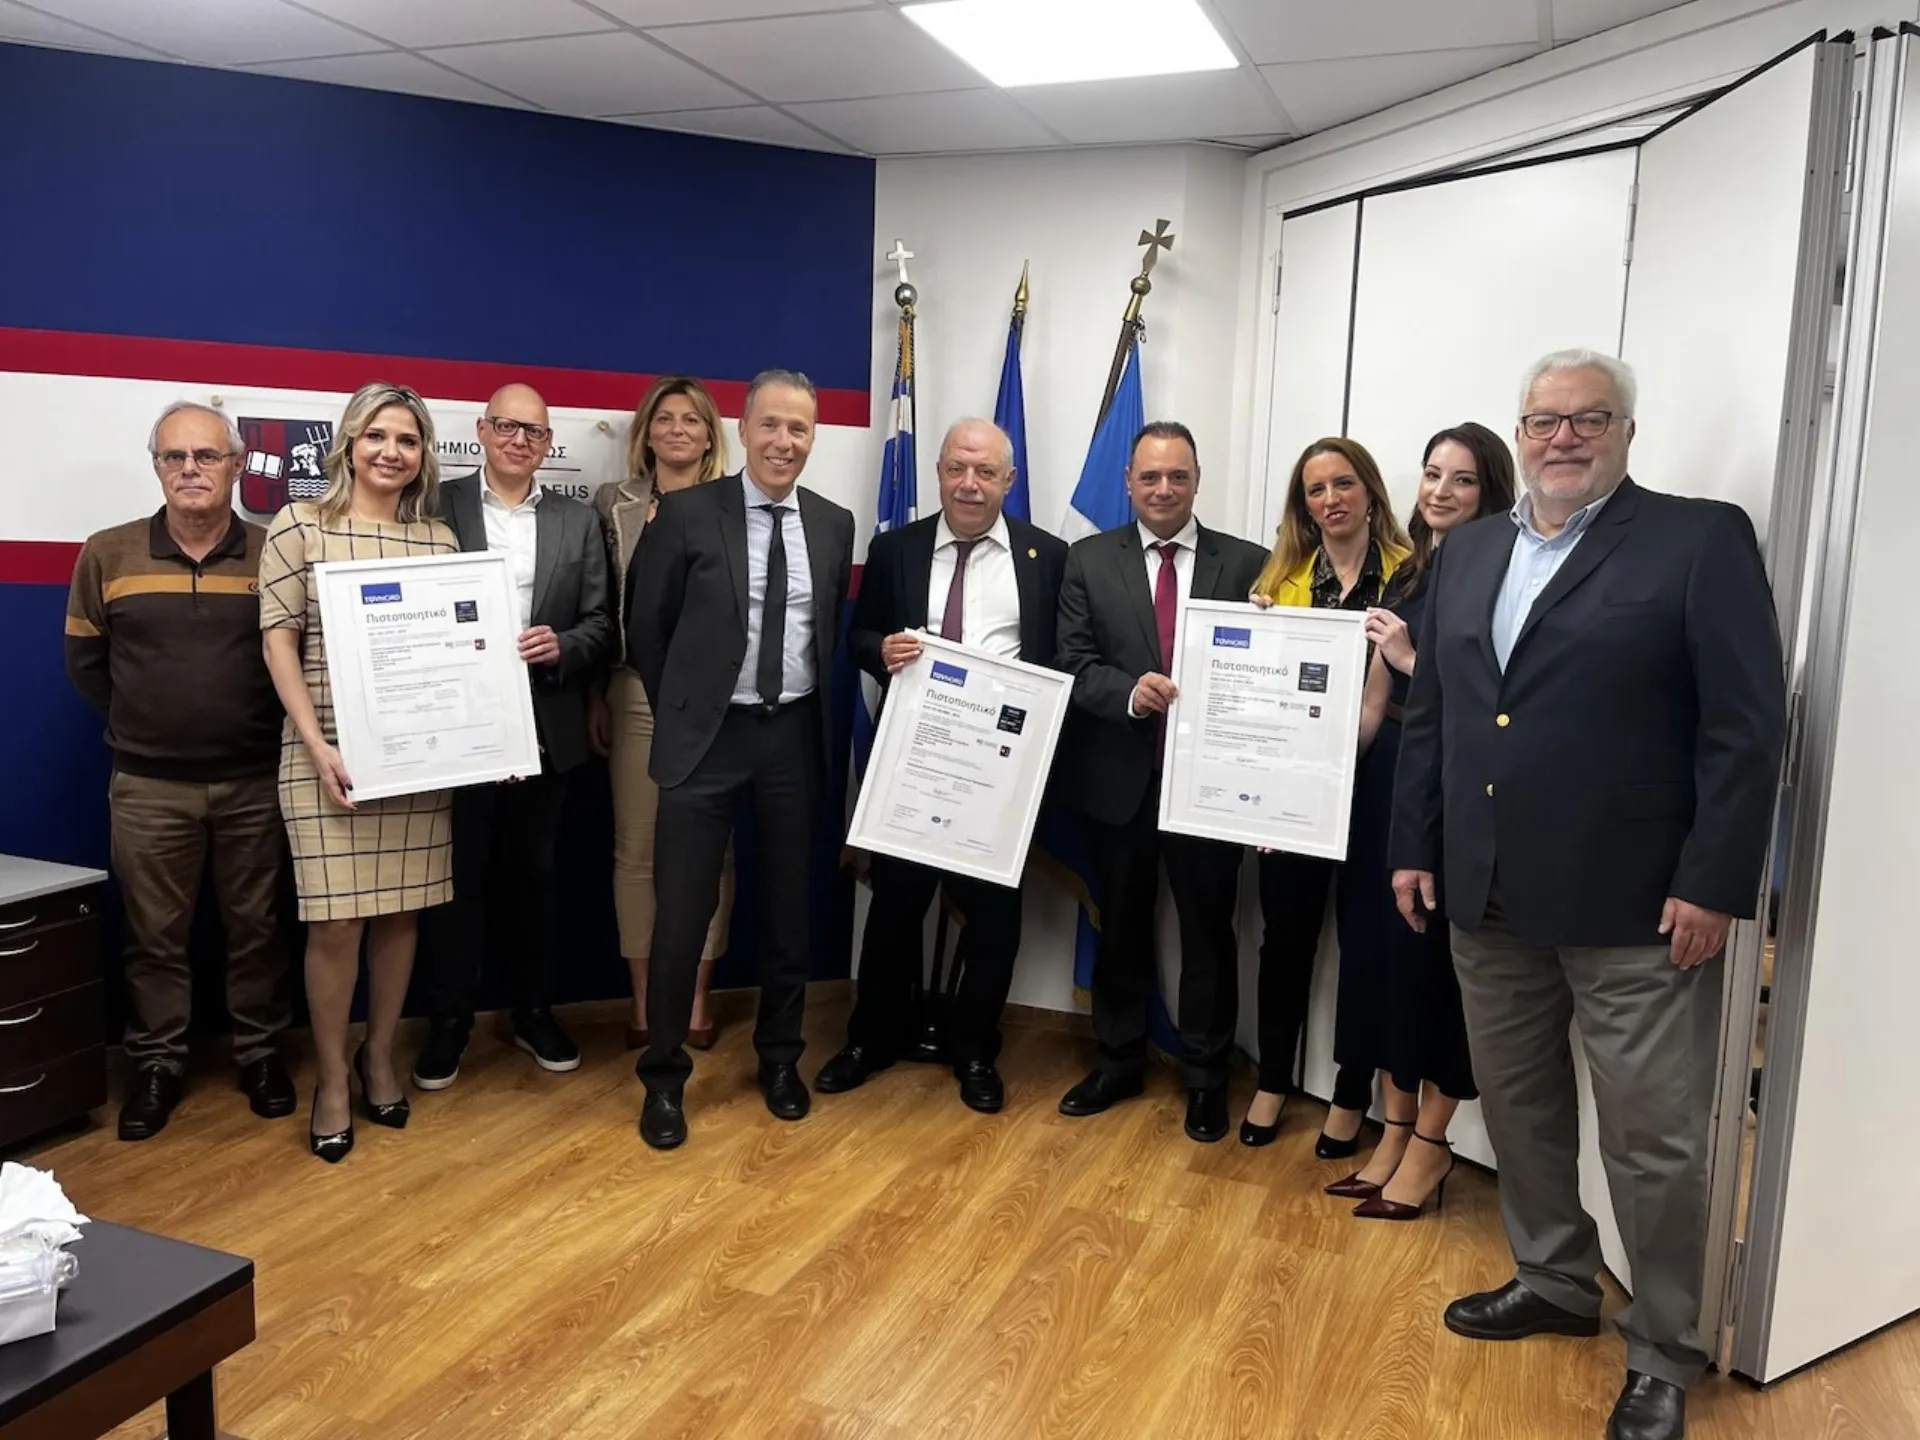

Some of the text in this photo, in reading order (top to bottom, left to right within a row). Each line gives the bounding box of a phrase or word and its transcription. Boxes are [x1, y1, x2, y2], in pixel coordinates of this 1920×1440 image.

[436, 441, 566, 459] ΗΜΙΟ ΩΣ
[547, 483, 589, 499] EUS
[366, 607, 447, 623] Πιστοποιητικό
[1211, 659, 1289, 677] Πιστοποιητικό
[926, 688, 997, 717] Πιστοποιητικό
